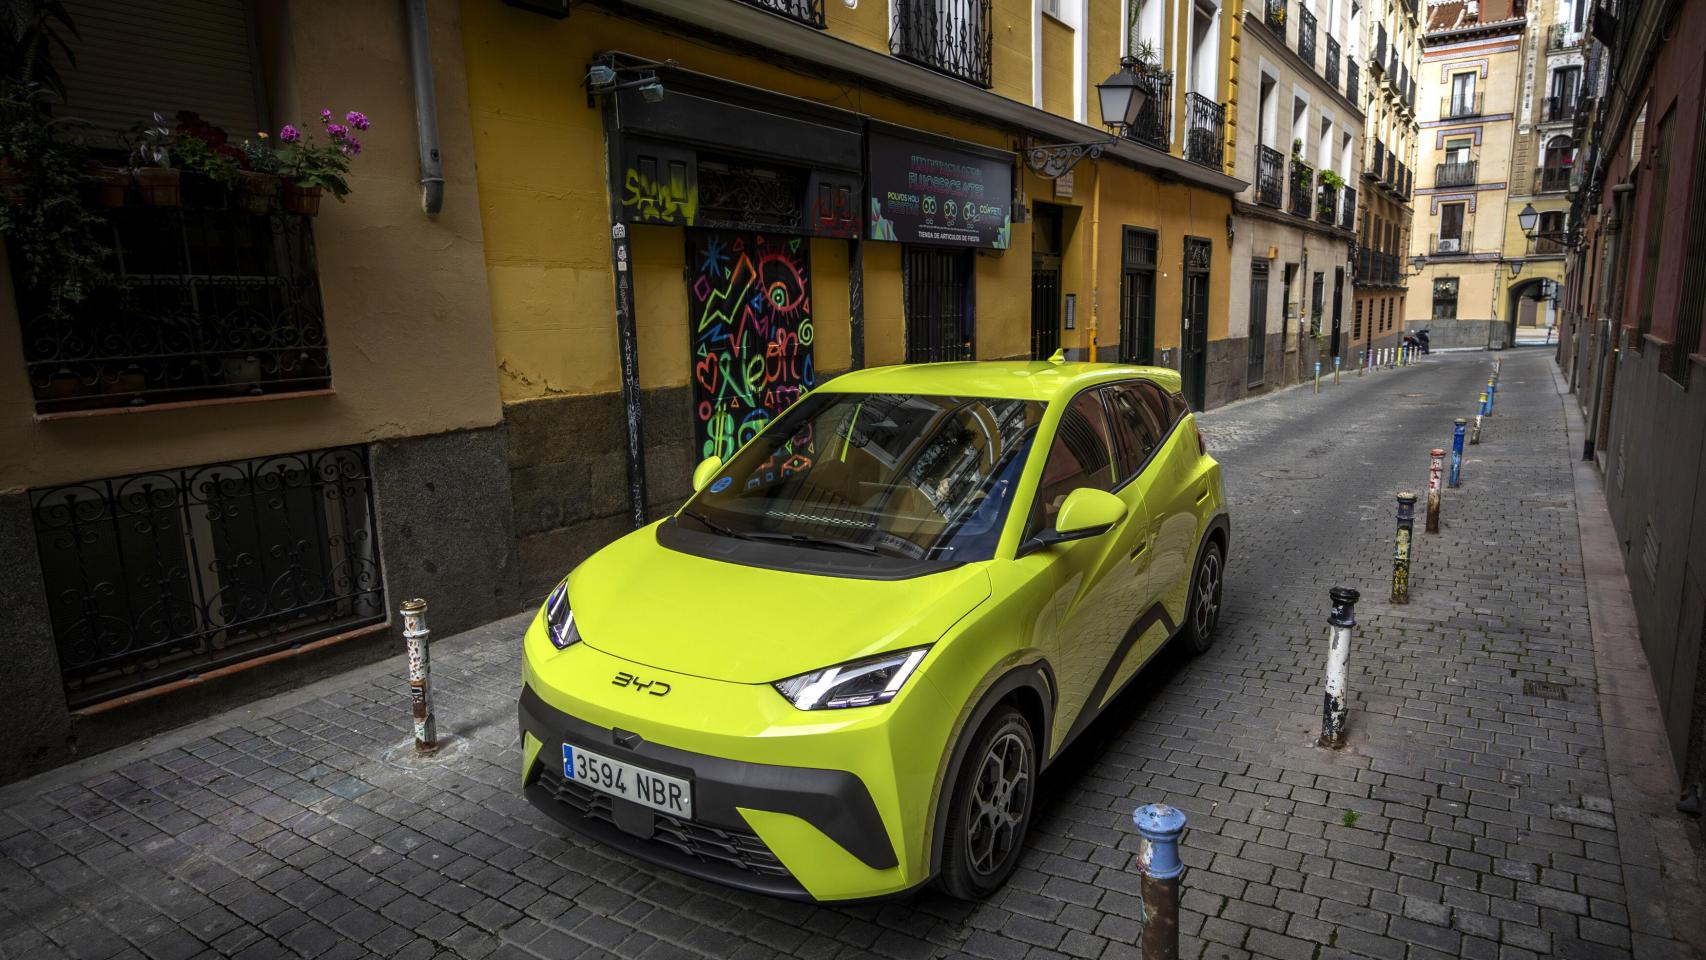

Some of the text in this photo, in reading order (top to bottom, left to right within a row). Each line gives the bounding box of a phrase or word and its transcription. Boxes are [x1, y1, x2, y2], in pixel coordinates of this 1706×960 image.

[888, 191, 907, 201] POLVOS
[918, 231, 933, 239] TIENDA
[612, 671, 672, 697] BYD
[567, 765, 572, 773] E
[577, 754, 682, 811] 3594 NBR
